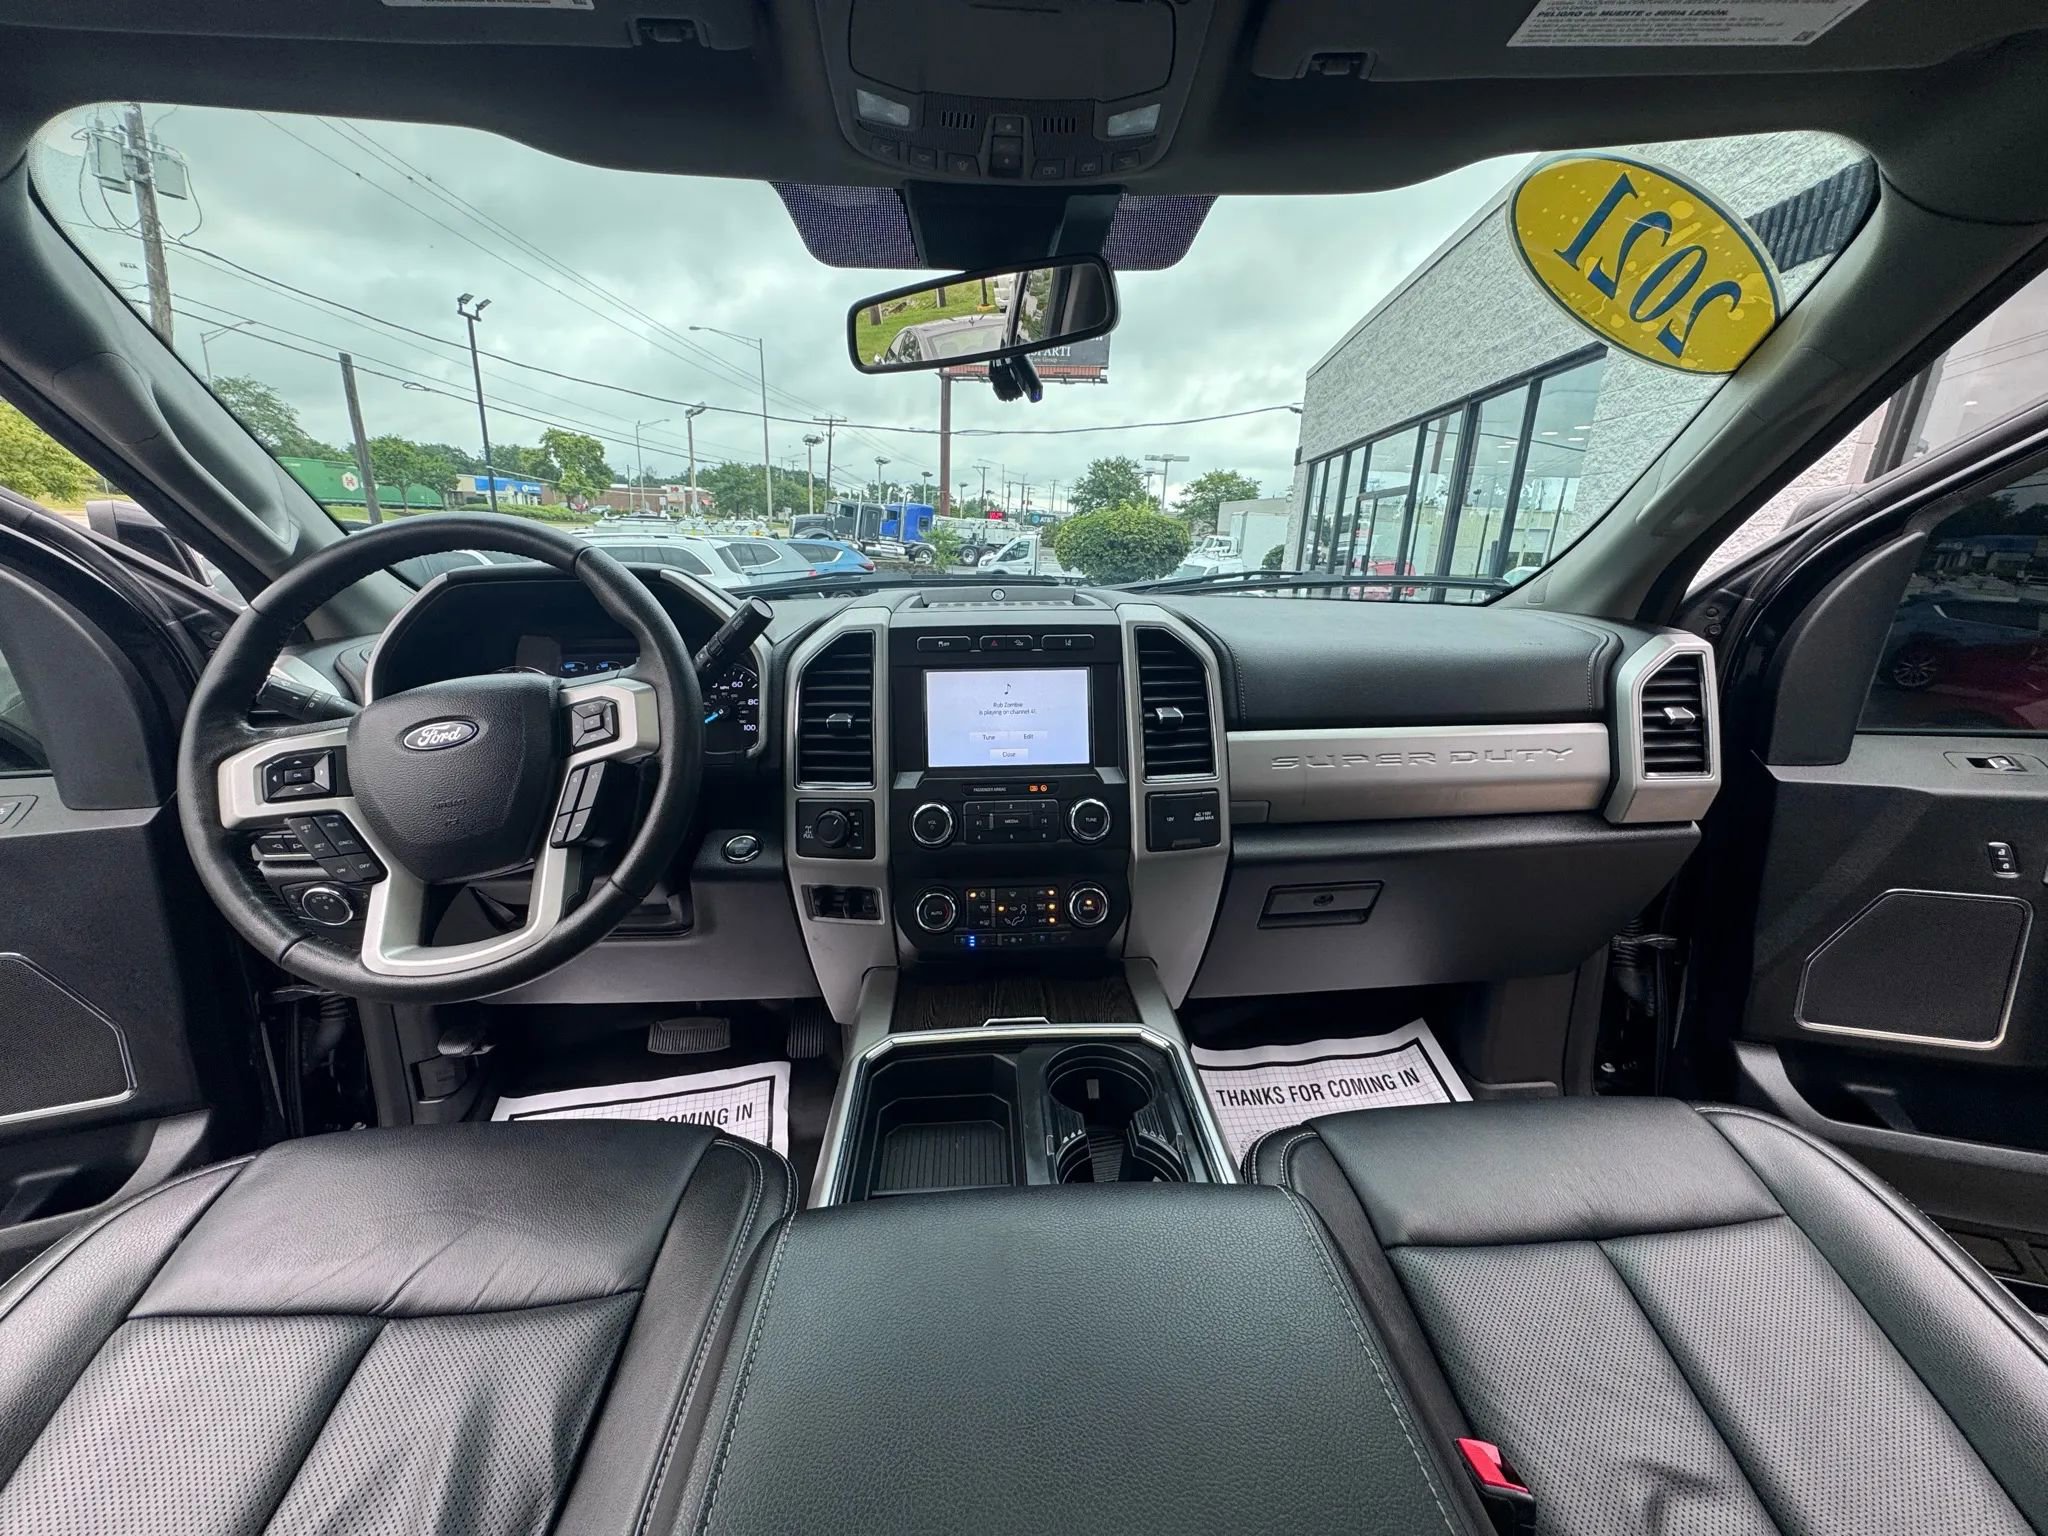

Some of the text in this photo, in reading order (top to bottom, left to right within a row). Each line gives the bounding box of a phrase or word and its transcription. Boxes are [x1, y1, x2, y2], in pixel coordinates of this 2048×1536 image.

[417, 725, 462, 747] Ford
[1271, 748, 1573, 770] SUPER DUTY
[1216, 1067, 1421, 1107] THANKS FOR COMING IN
[735, 1103, 753, 1122] IN
